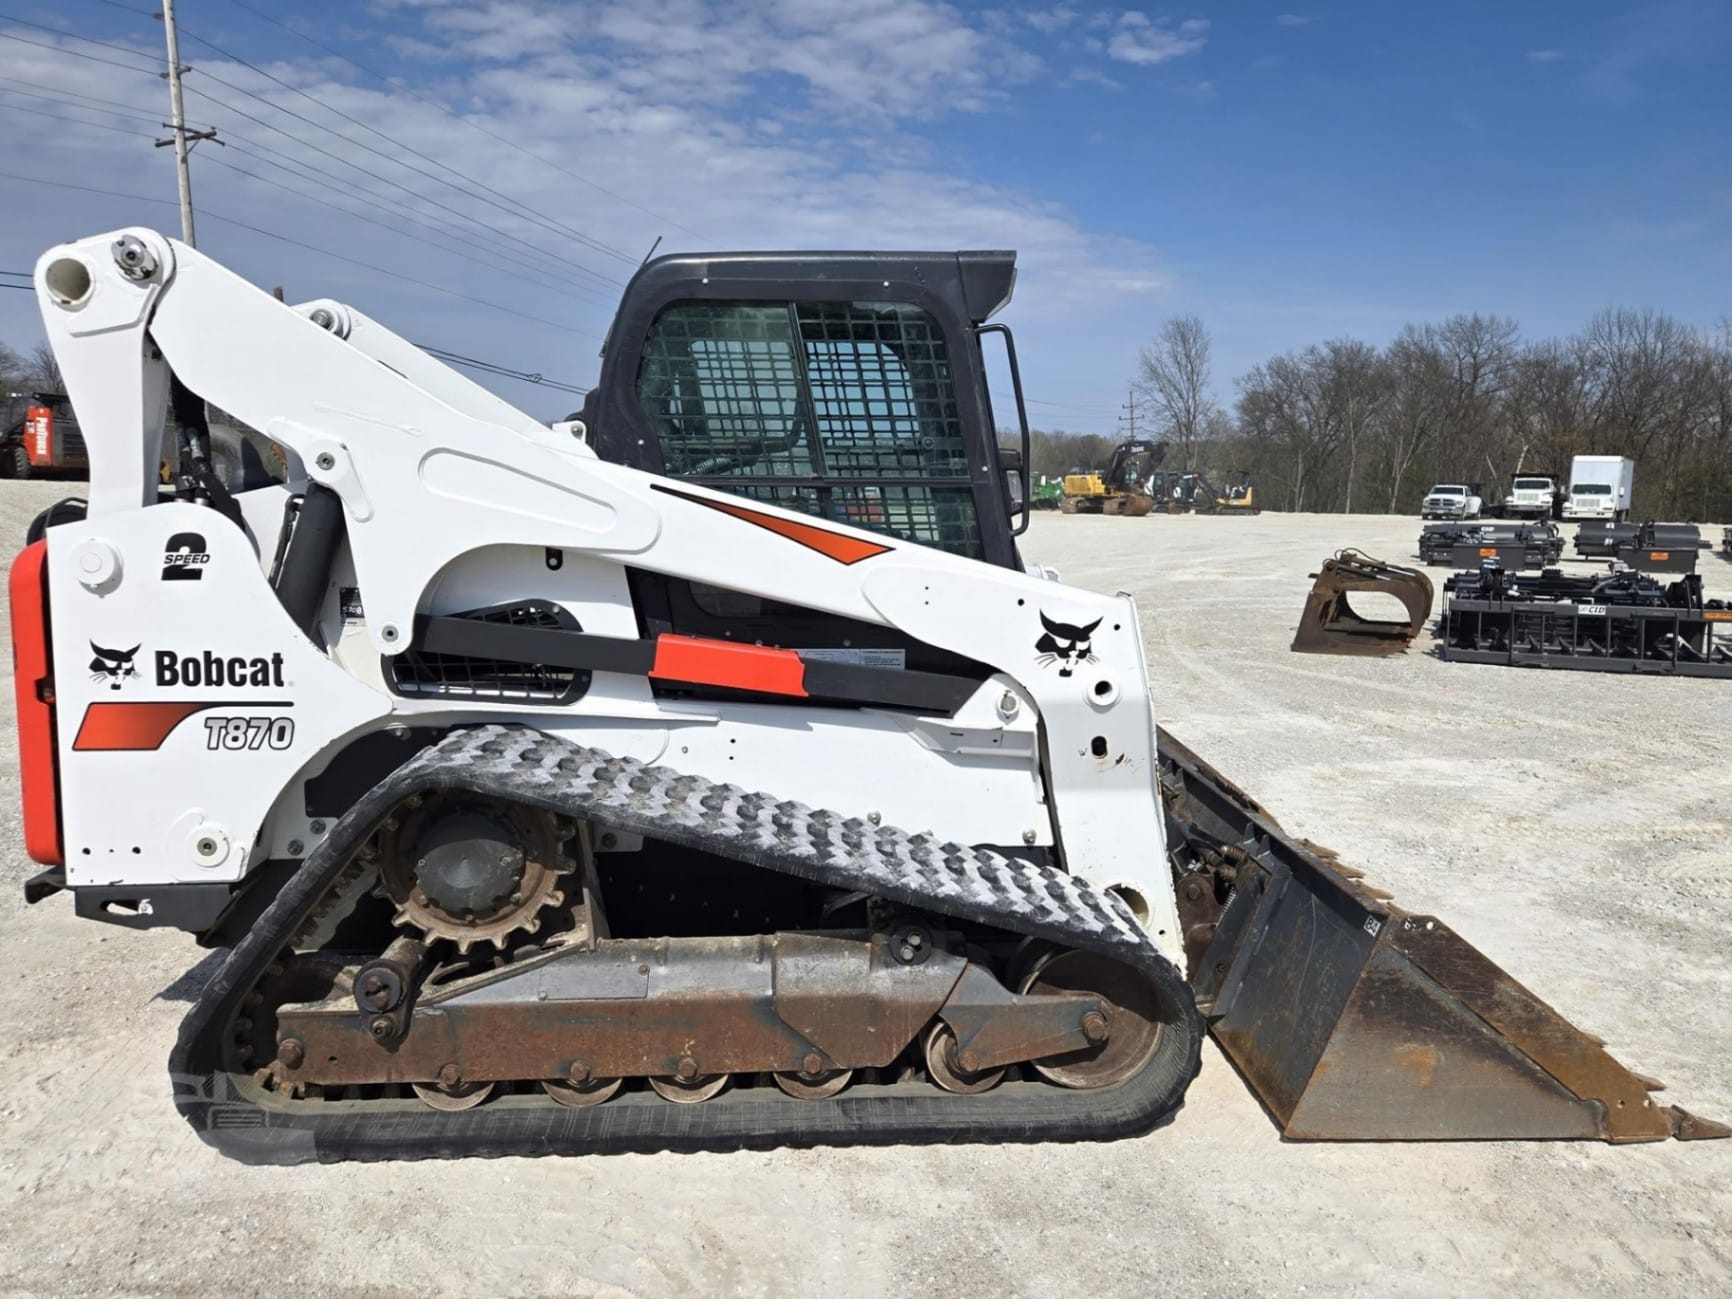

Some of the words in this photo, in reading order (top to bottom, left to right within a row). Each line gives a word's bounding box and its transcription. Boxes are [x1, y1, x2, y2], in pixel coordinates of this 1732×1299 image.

[161, 532, 207, 581] 2
[163, 554, 210, 564] SPEED
[155, 650, 284, 687] Bobcat
[204, 717, 295, 750] T870
